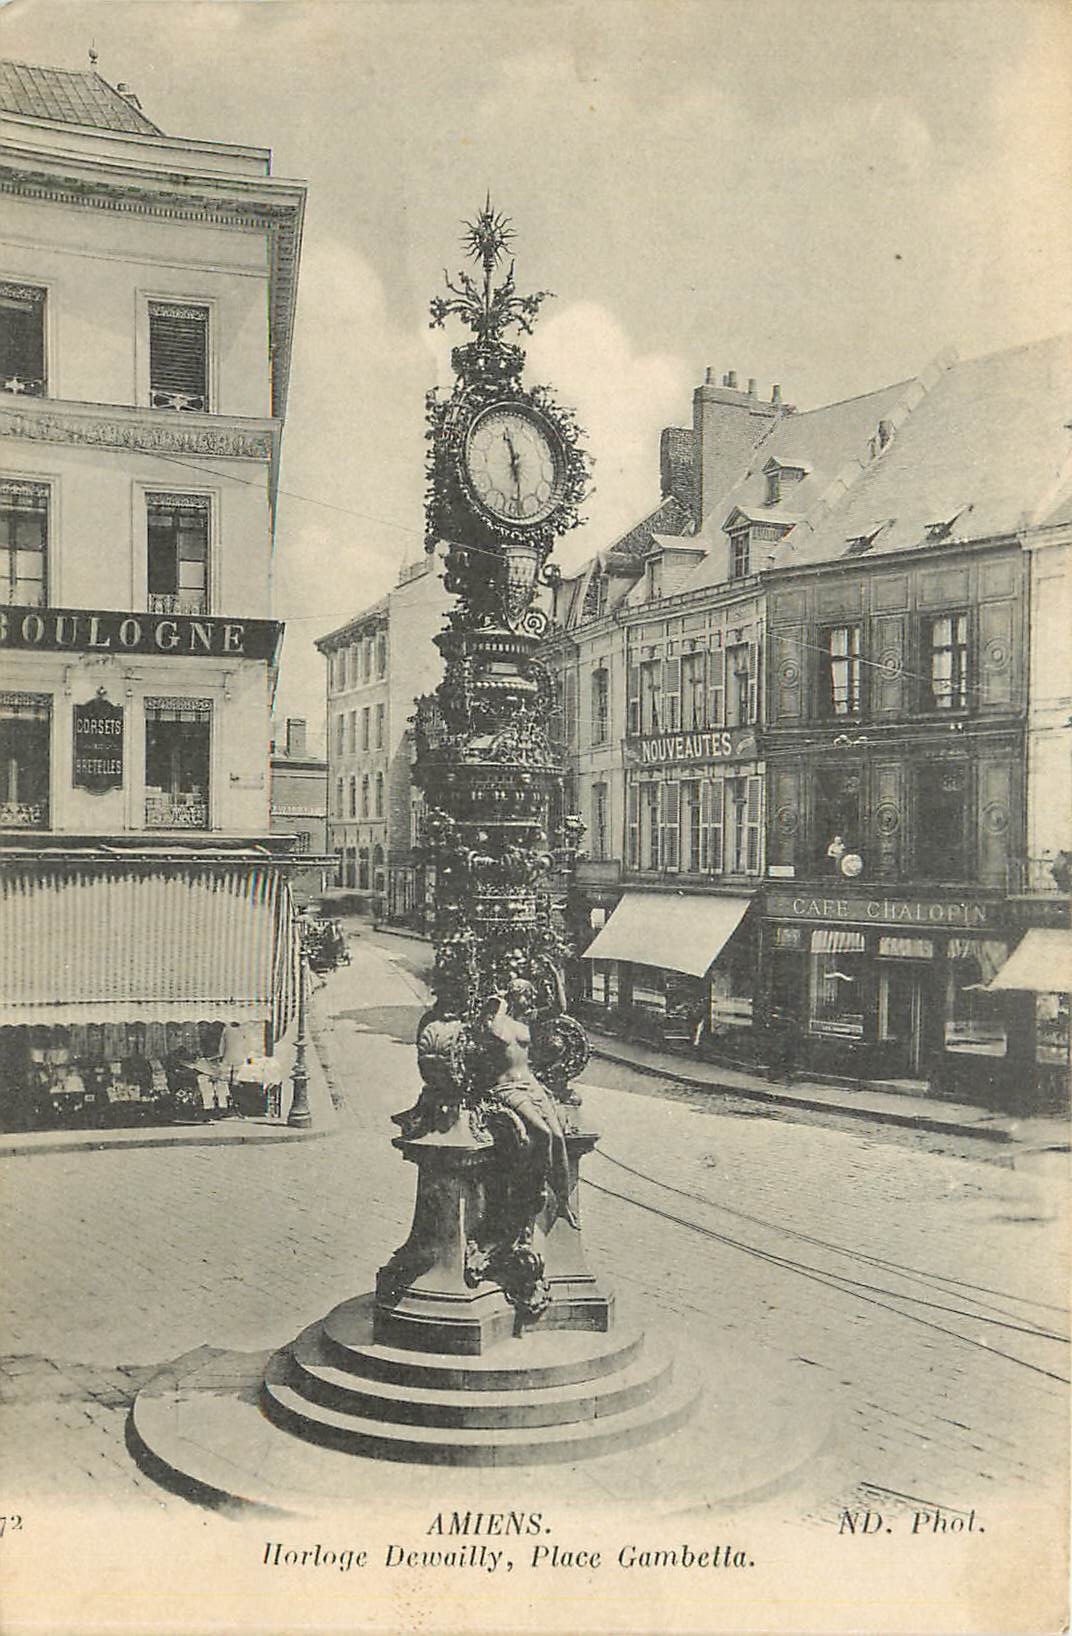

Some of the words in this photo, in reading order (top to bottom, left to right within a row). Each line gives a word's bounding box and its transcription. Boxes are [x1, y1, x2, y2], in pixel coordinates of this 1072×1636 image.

[76, 718, 122, 735] CORSETS
[76, 759, 122, 775] BRETELLES
[866, 898, 988, 923] CHALOPIN
